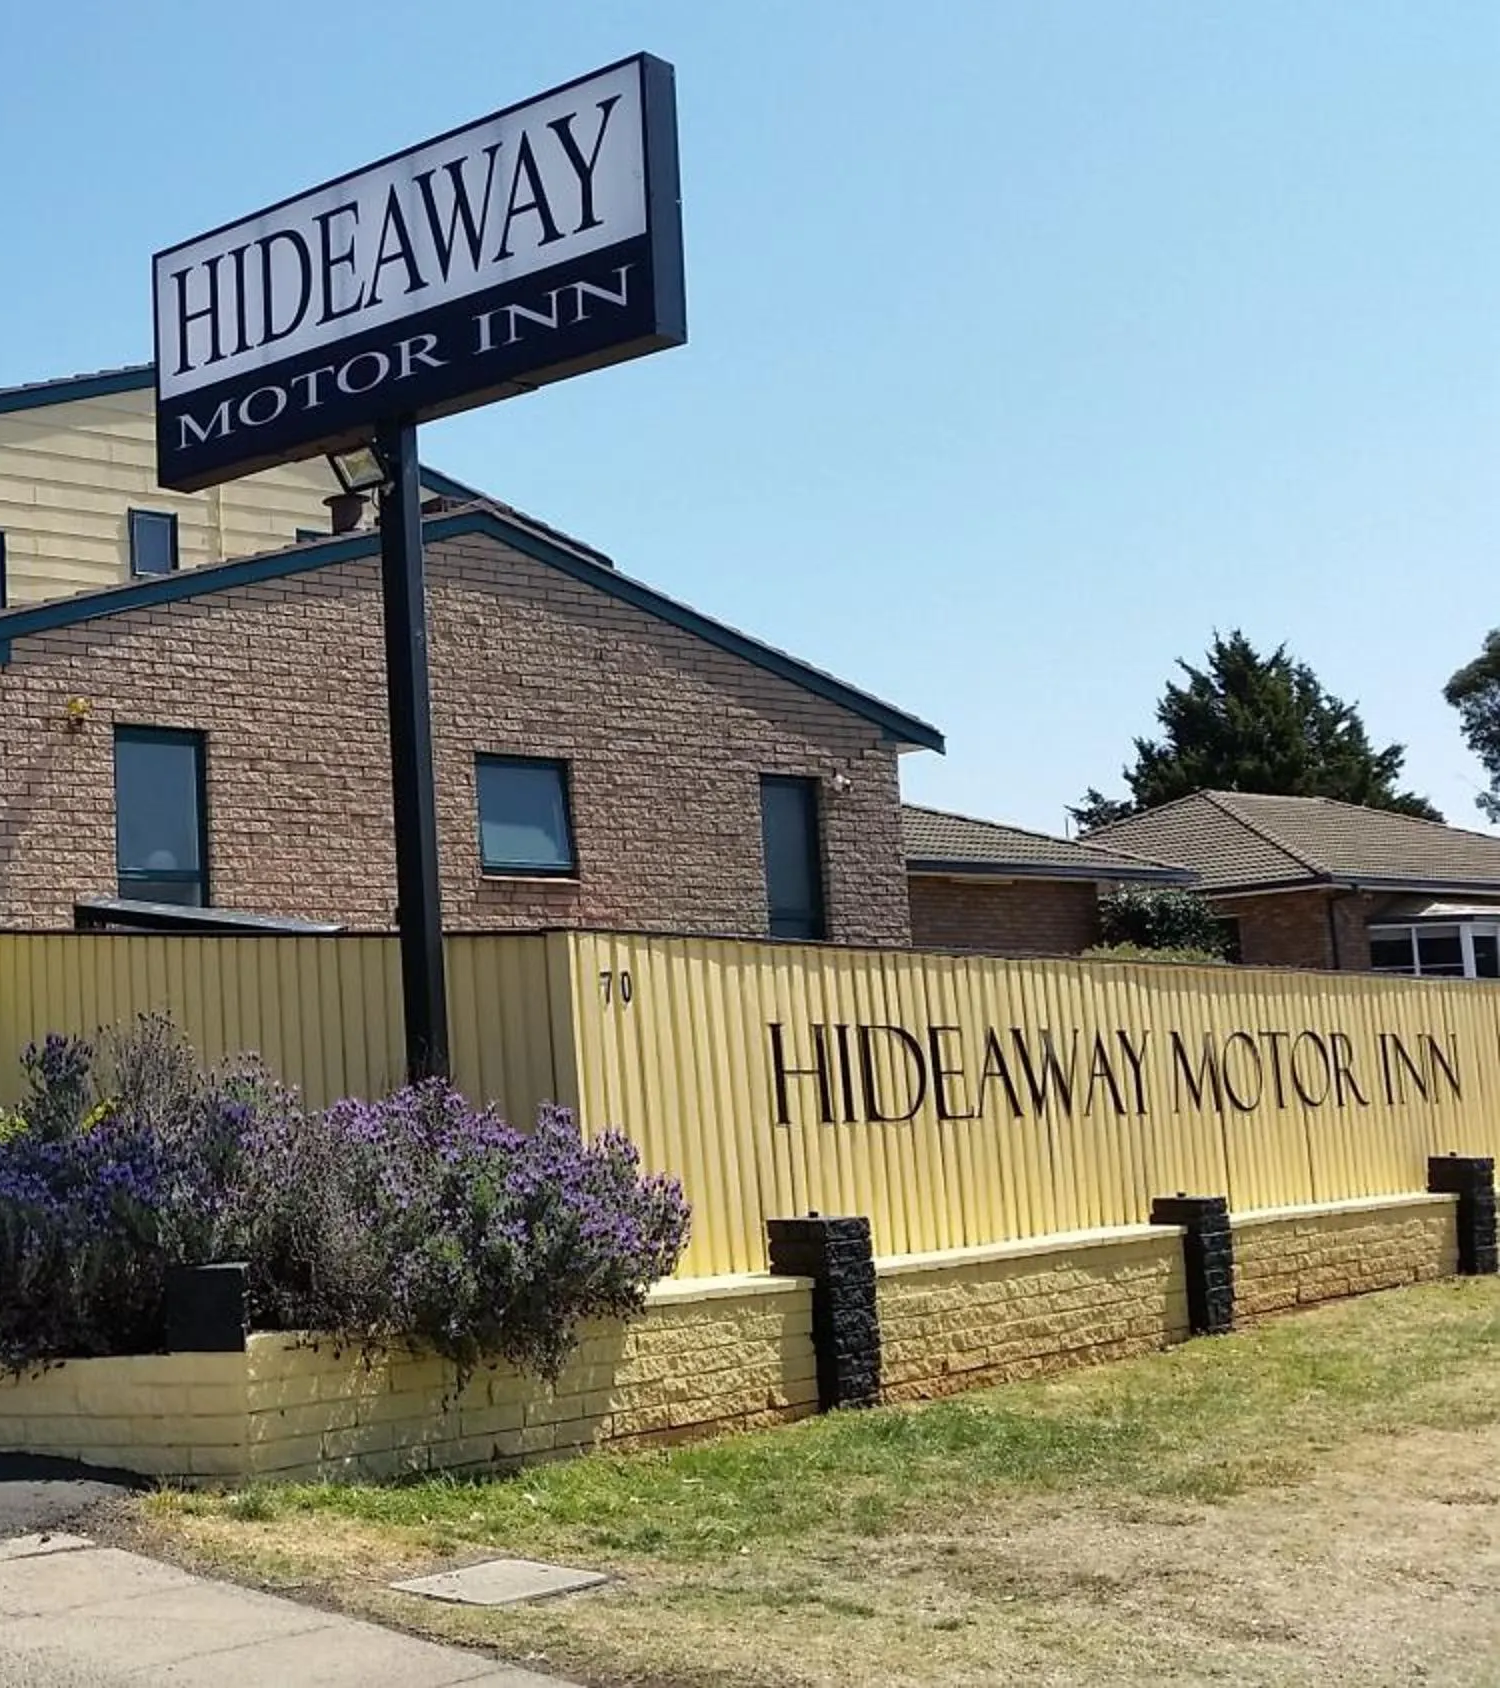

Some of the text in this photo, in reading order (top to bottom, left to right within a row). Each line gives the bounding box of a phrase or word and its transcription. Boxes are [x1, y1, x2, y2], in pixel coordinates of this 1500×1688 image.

[171, 93, 623, 377] HIDEAWAY
[174, 263, 635, 450] MOTOR INN
[599, 971, 632, 1004] 70
[767, 1022, 1463, 1125] HIDEAWAY MOTOR INN
